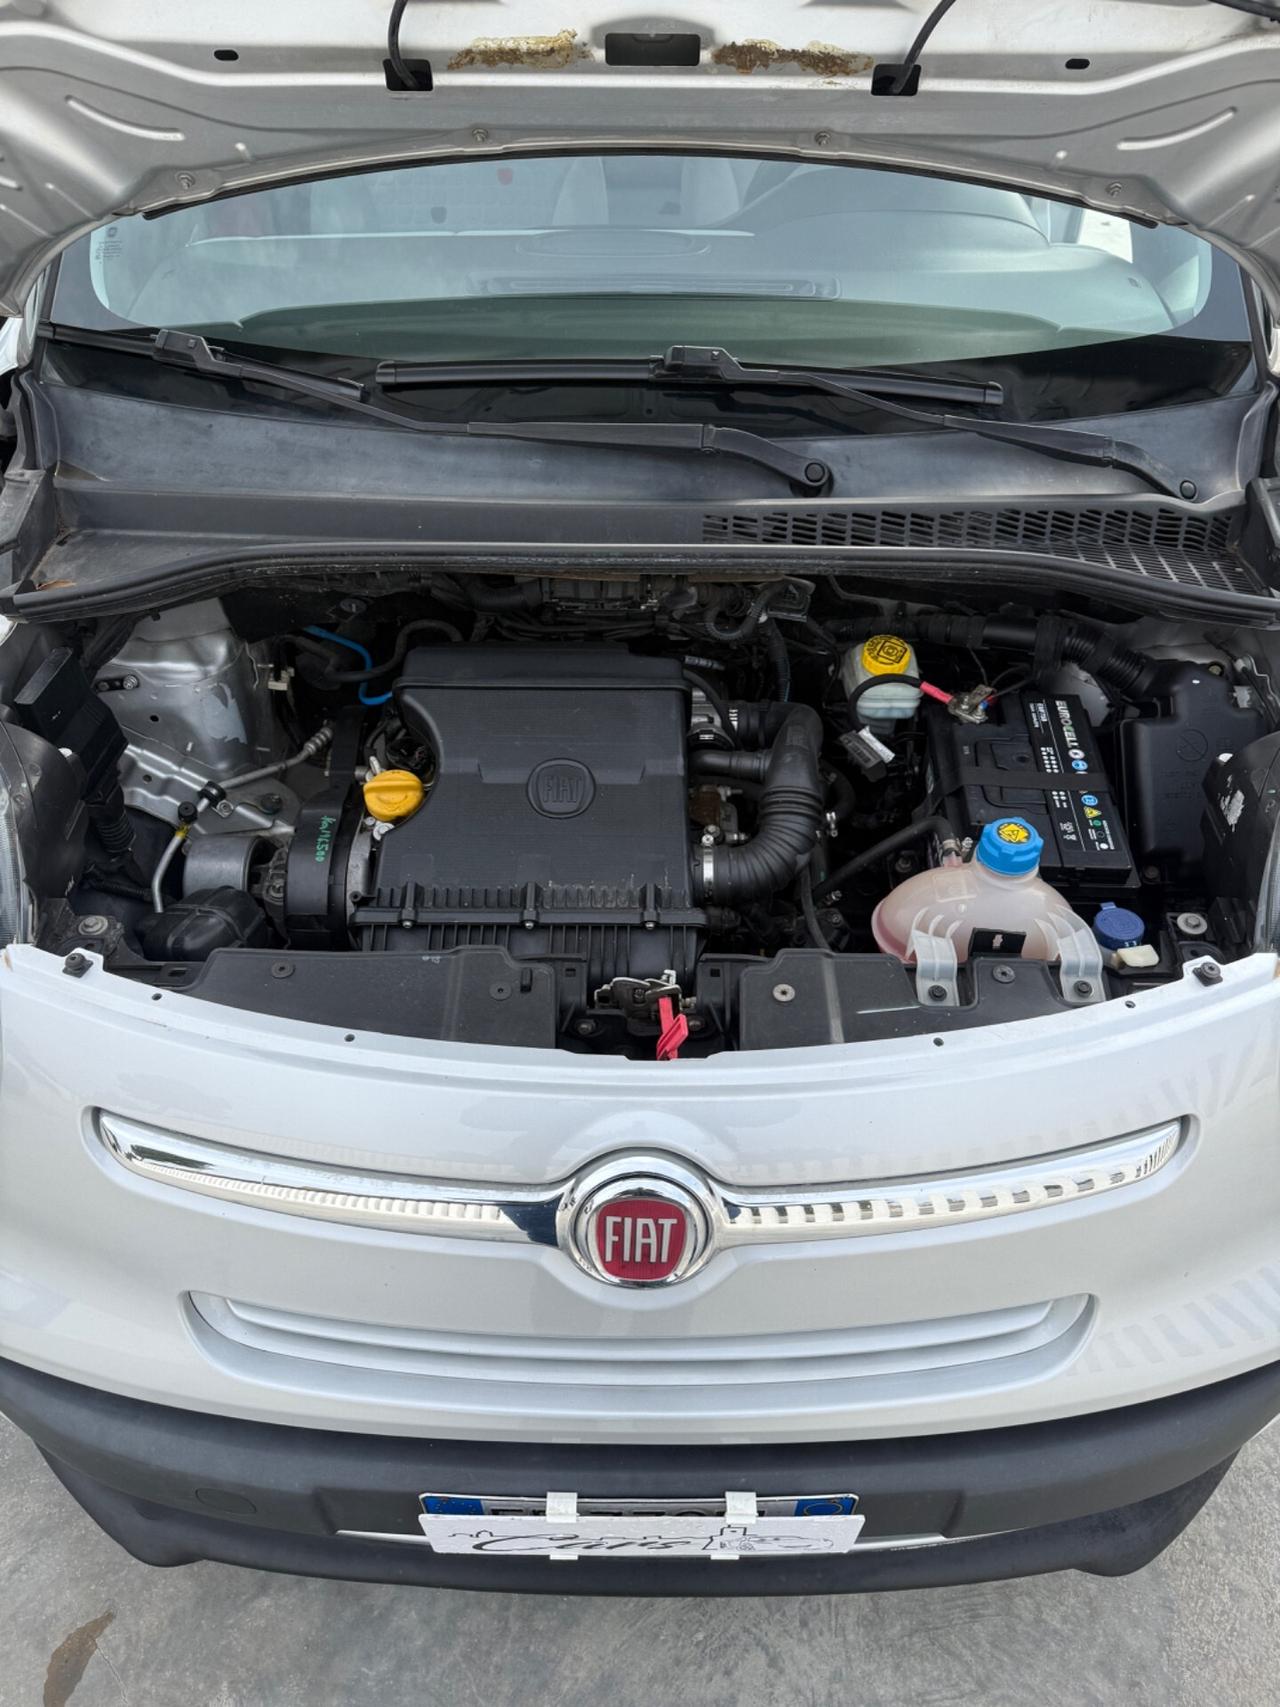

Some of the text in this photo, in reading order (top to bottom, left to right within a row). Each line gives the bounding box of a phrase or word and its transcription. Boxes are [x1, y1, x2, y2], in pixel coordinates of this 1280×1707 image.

[1055, 700, 1080, 748] EUROCELL
[542, 775, 582, 803] FIAT
[605, 1216, 677, 1263] FIAT
